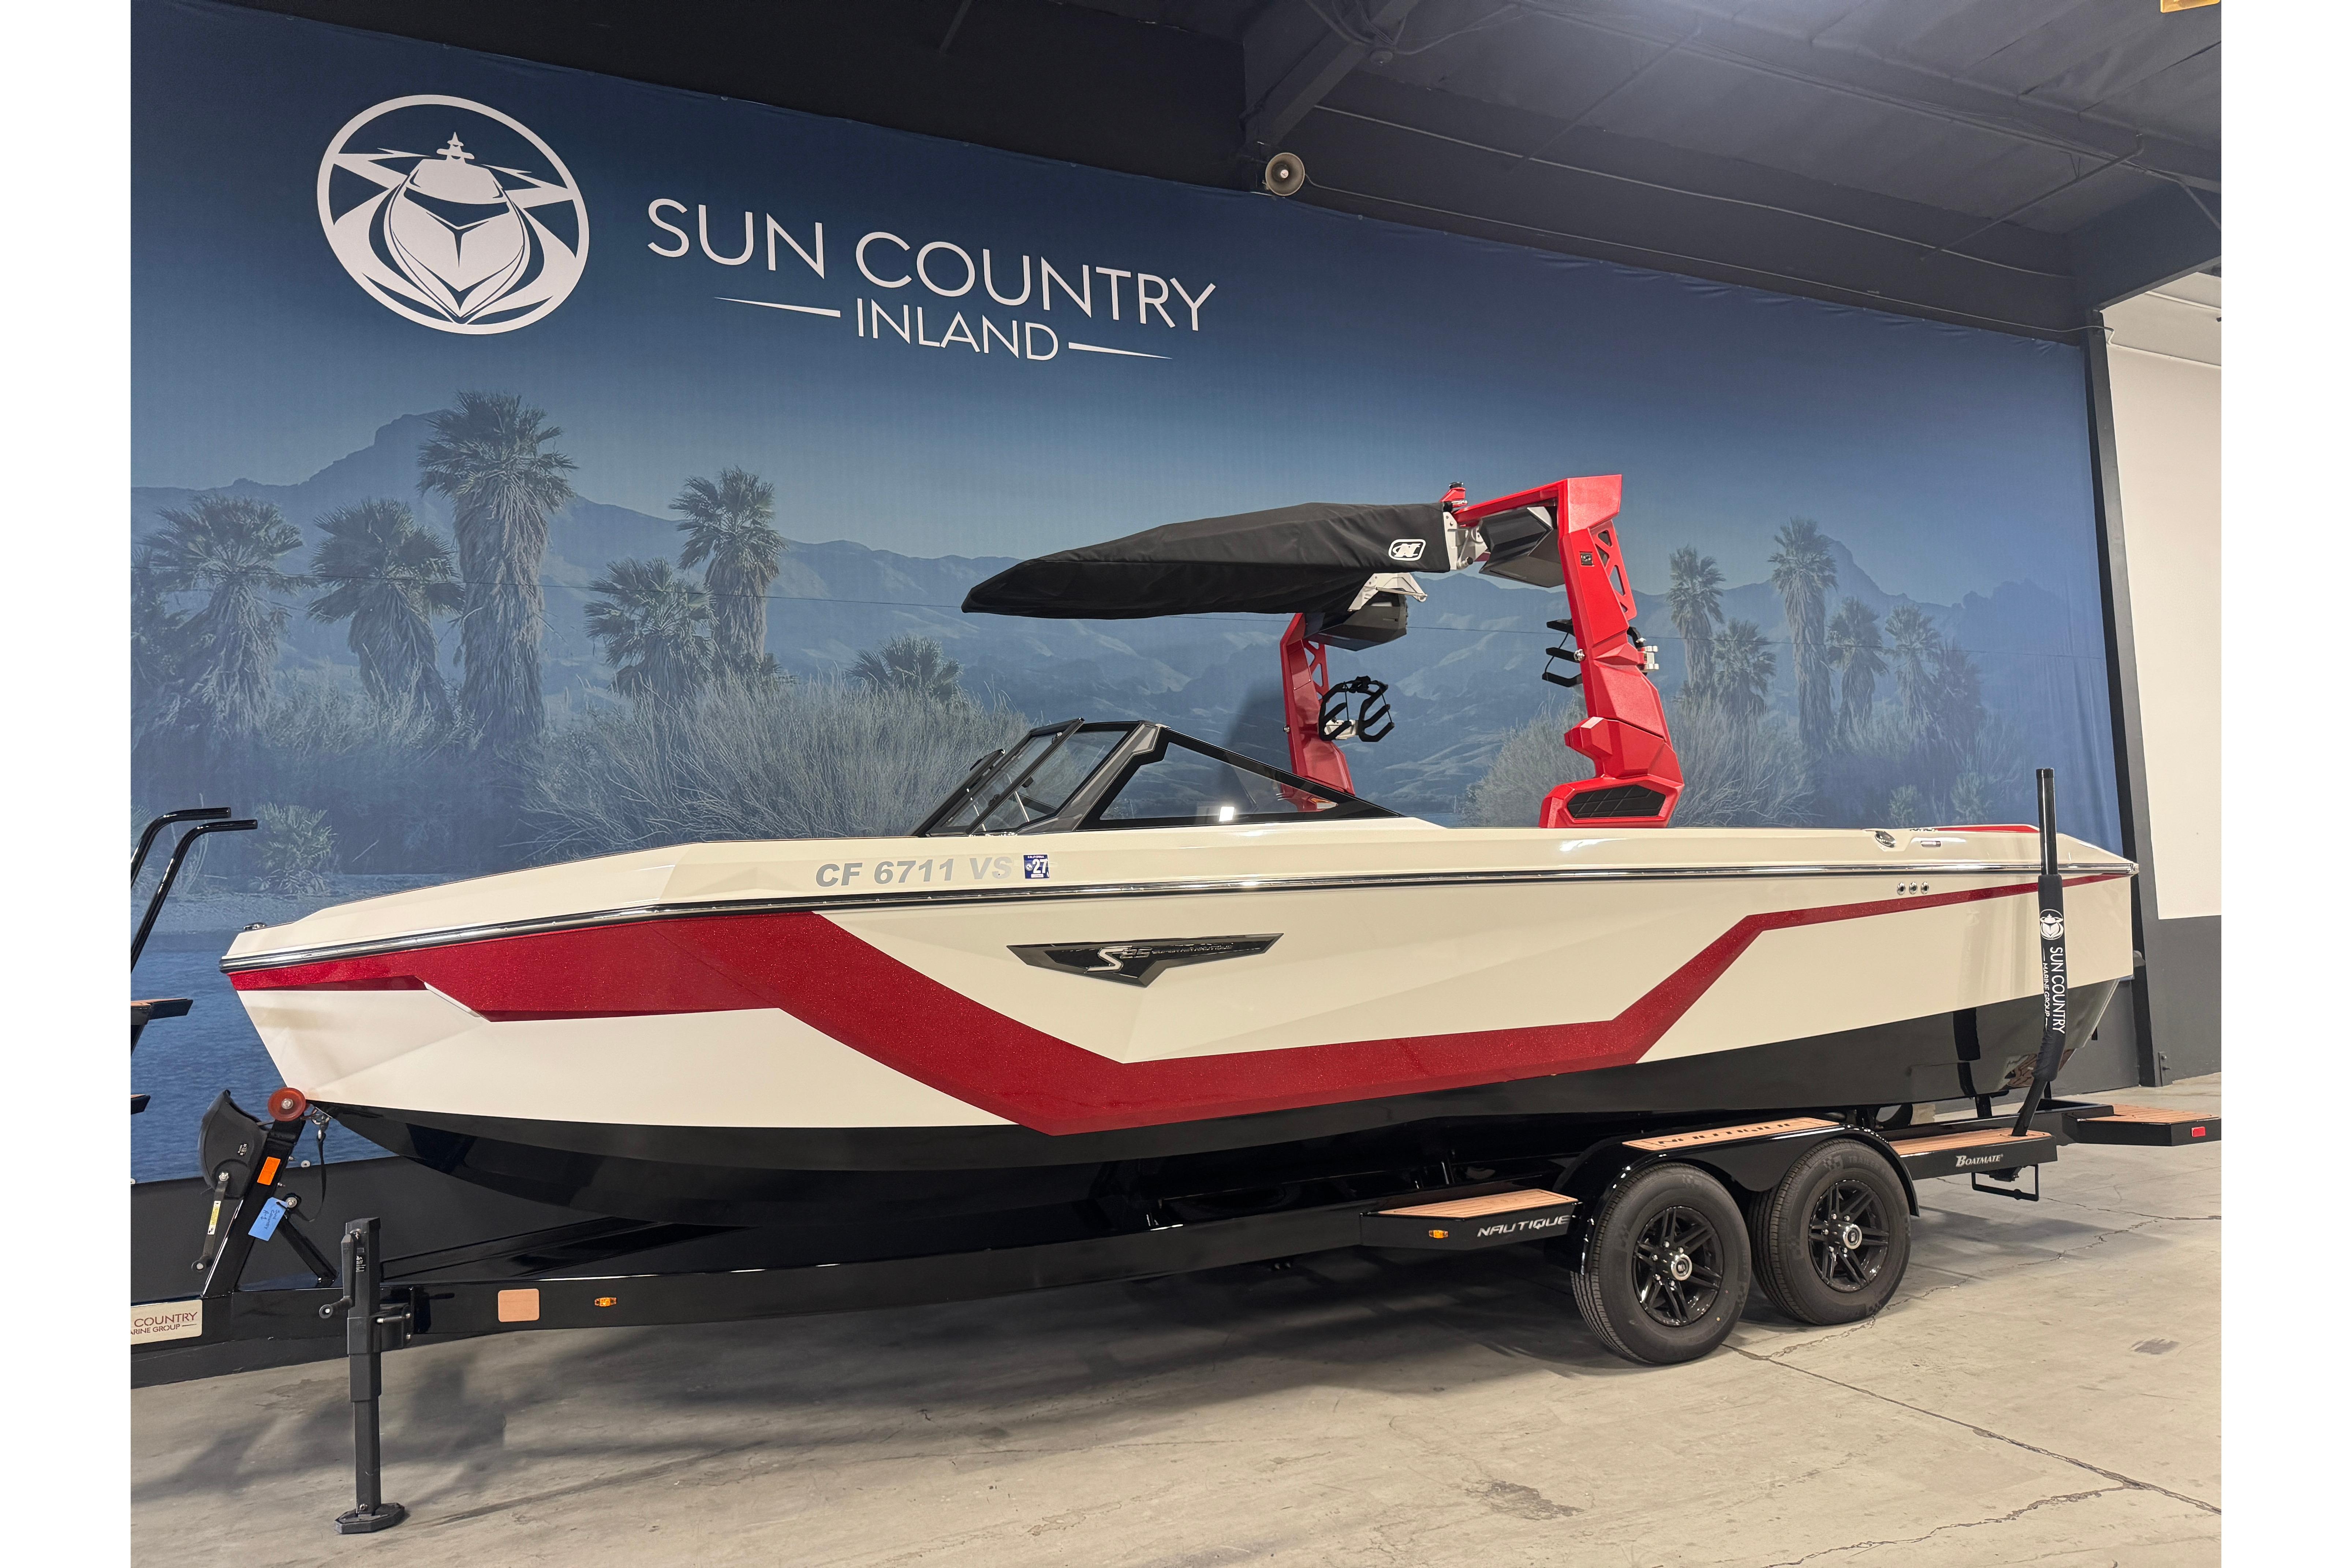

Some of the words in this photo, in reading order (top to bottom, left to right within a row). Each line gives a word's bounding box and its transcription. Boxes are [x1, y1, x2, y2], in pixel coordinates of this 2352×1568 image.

[648, 198, 824, 279] SUN
[855, 231, 1216, 331] COUNTRY
[857, 298, 1059, 361] INLAND
[816, 863, 862, 887] CF
[874, 858, 953, 884] 6711
[969, 856, 1013, 880] VS
[1032, 858, 1048, 874] 27
[2050, 947, 2064, 972] SUN
[2051, 975, 2065, 1034] COUNTRY
[1477, 1215, 1571, 1237] NAUTIQUE
[134, 1312, 198, 1327] COUNTRY
[153, 1324, 180, 1332] GROUP
